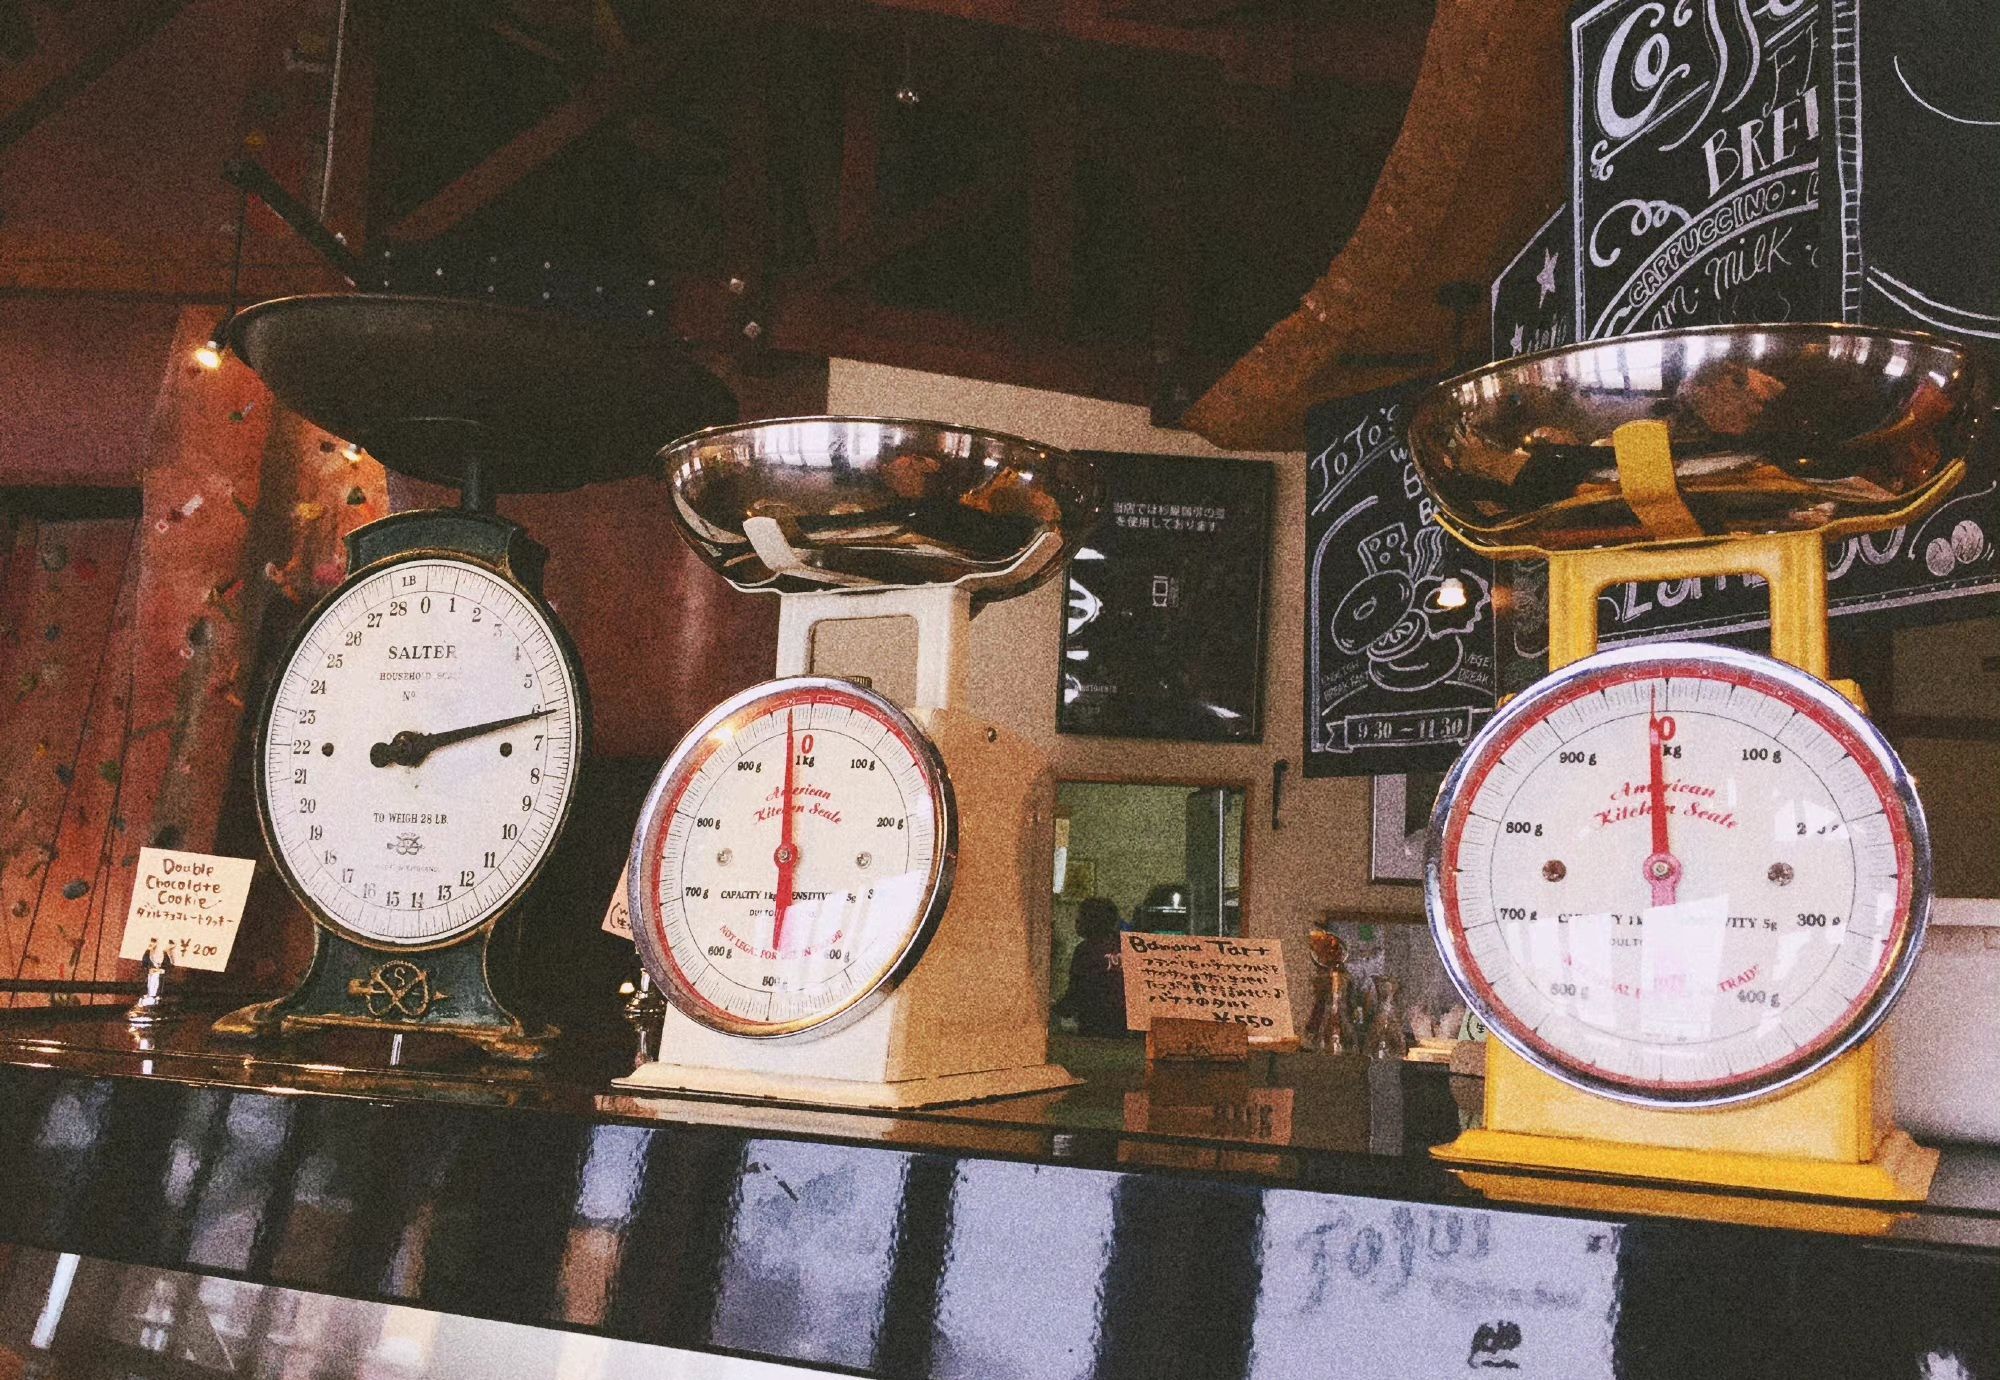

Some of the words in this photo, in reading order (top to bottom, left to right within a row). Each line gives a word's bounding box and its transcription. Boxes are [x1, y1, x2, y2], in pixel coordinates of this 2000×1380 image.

[1629, 181, 1786, 307] CAPPUCCINO
[402, 575, 417, 587] LB
[389, 601, 408, 617] 28
[420, 596, 431, 614] 0
[450, 597, 456, 612] 1
[367, 613, 383, 628] 27
[471, 607, 482, 623] 2
[345, 631, 362, 647] 26
[388, 645, 457, 660] SALTER
[327, 654, 343, 669] 25
[310, 679, 327, 695] 24
[523, 674, 533, 689] 5
[299, 709, 316, 724] 23
[1658, 715, 1677, 741] 0
[293, 740, 311, 755] 22
[534, 735, 544, 751] 7
[801, 734, 814, 754] 0
[1559, 751, 1585, 764] 900
[1588, 752, 1597, 766] g
[1742, 748, 1769, 761] 100
[1772, 750, 1782, 764] g
[737, 761, 754, 772] 900
[755, 762, 762, 773] g
[850, 759, 867, 769] 100
[868, 760, 876, 771] g
[294, 768, 307, 784] 21
[530, 768, 540, 785] 8
[765, 784, 832, 802] Aerican
[1610, 779, 1716, 801] Amrican
[300, 798, 316, 814] 20
[522, 795, 532, 811] 9
[374, 812, 385, 823] TO
[388, 812, 418, 824] WEIGH
[420, 813, 432, 824] 28
[809, 802, 842, 825] Scale
[1594, 800, 1676, 826] Kitchn
[1683, 800, 1740, 830] Scale
[501, 823, 518, 840] 10
[697, 818, 713, 828] 800
[715, 819, 721, 830] g
[876, 818, 894, 828] 200
[897, 819, 904, 830] g
[1506, 821, 1531, 834] 800
[1535, 823, 1543, 837] g
[309, 824, 323, 841] 19
[163, 858, 214, 877] Double
[484, 851, 496, 868] 11
[342, 868, 354, 884] 17
[459, 871, 475, 887] 12
[146, 875, 221, 894] Chocolate
[363, 882, 376, 899] 16
[158, 890, 220, 909] Cookie
[386, 891, 400, 907] 15
[411, 891, 424, 909] 14
[437, 885, 452, 901] 13
[685, 887, 702, 897] 700
[703, 889, 709, 899] g
[721, 890, 760, 899] CAPACITY
[1500, 908, 1526, 921] 700
[1797, 913, 1826, 928] 300
[719, 924, 734, 941] NOT
[735, 934, 757, 957] LEGA
[760, 950, 778, 960] FOR
[1129, 935, 1203, 954] Banana
[1204, 940, 1270, 957] Tart
[707, 946, 724, 956] 600
[725, 948, 732, 959] g
[825, 949, 841, 960] 00
[1149, 990, 1250, 1009] バナナのタルト
